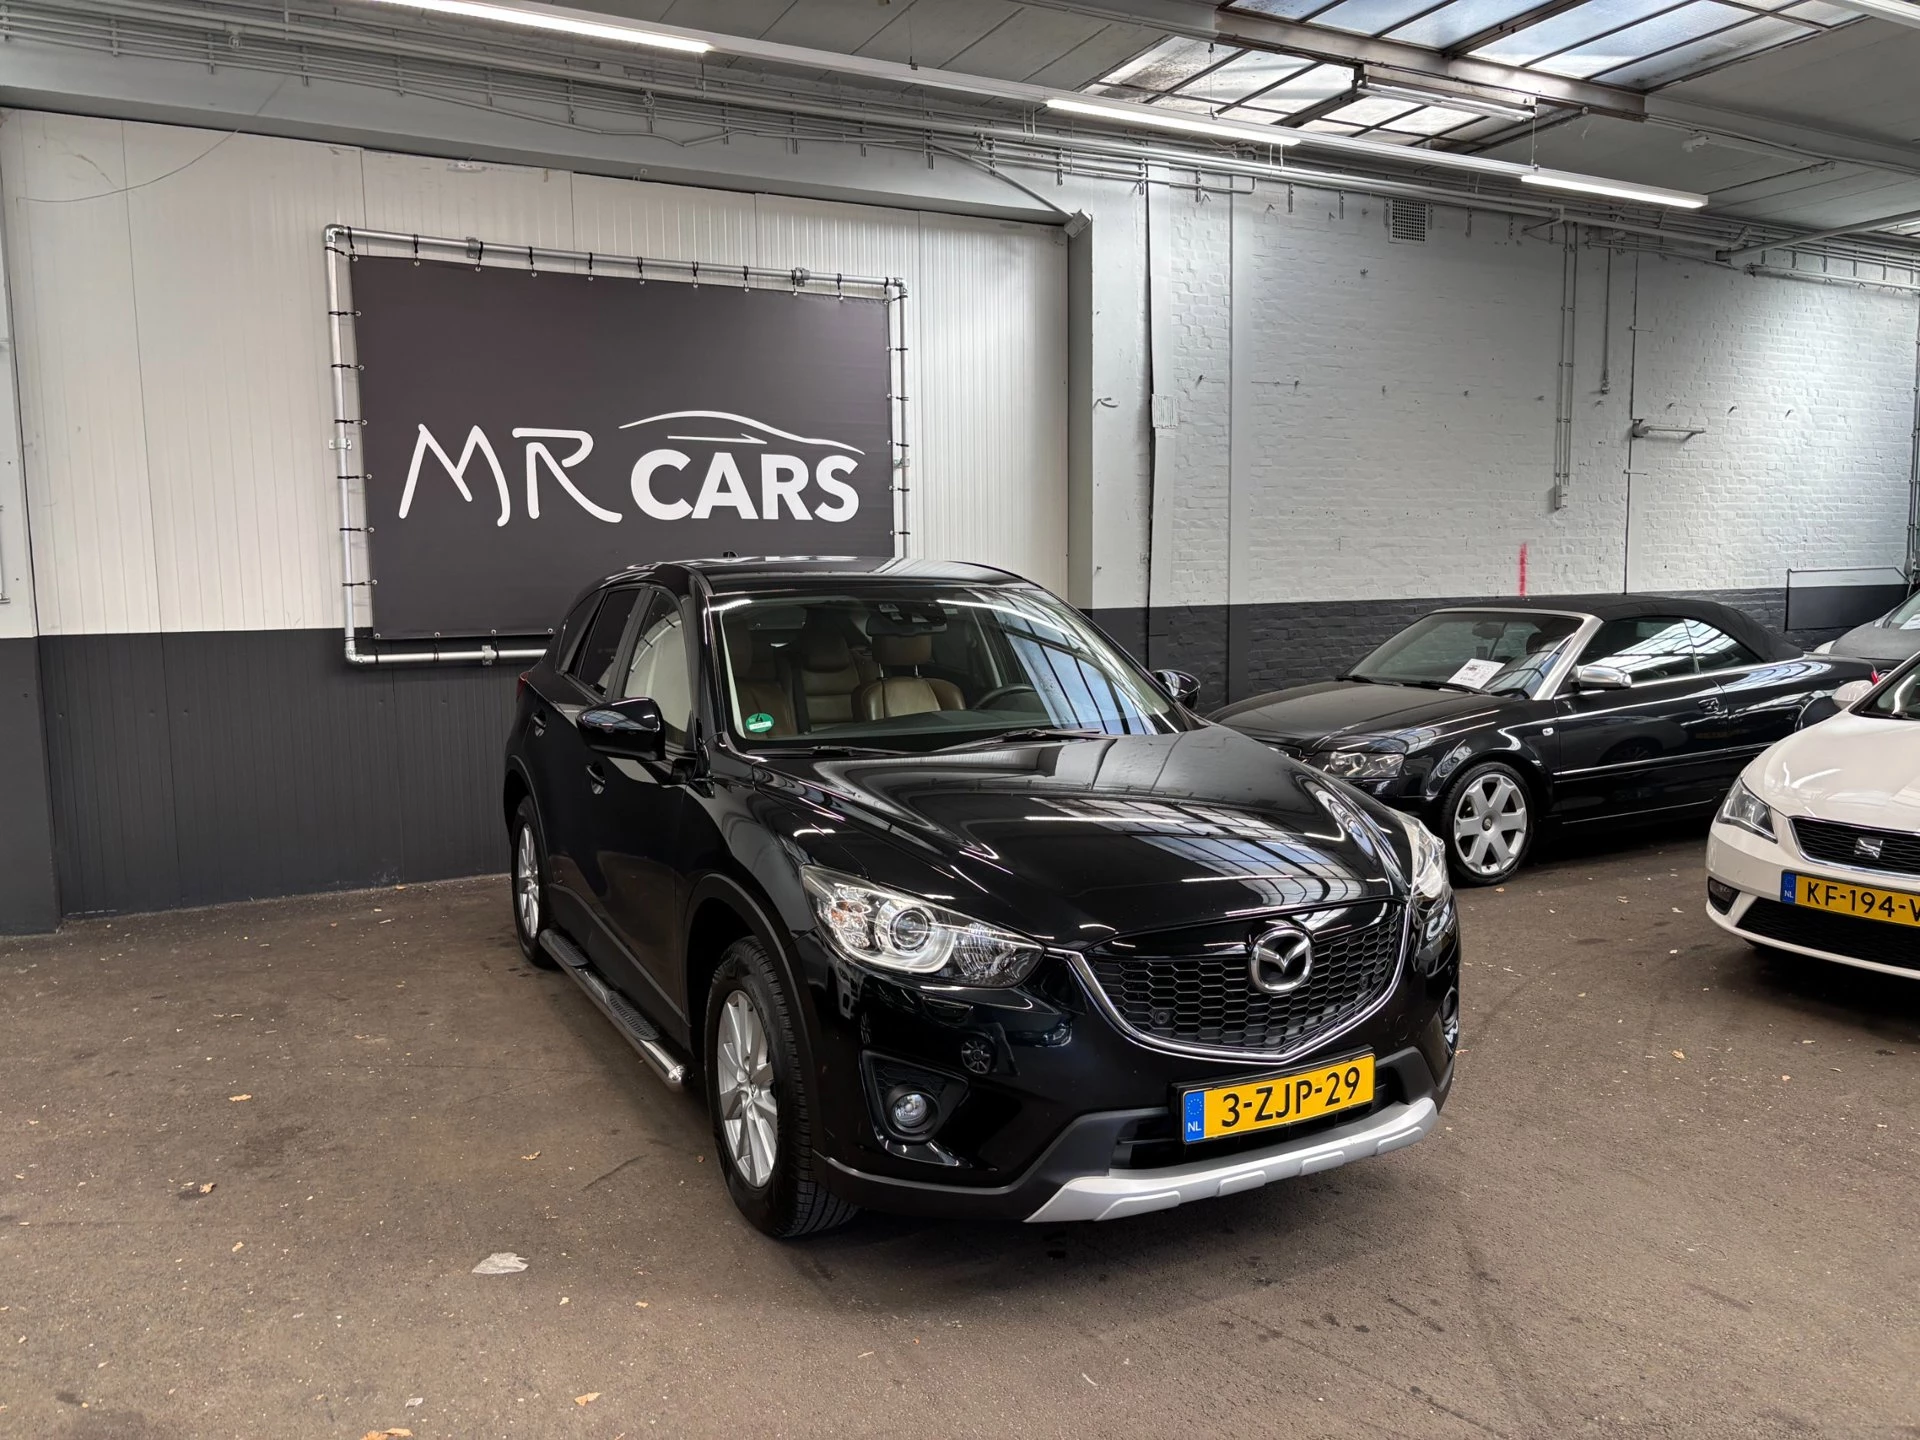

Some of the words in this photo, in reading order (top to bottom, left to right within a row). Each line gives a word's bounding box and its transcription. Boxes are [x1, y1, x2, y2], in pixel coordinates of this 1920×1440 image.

[398, 423, 623, 527] MR
[630, 448, 860, 523] CARS
[1783, 890, 1794, 899] NL
[1187, 1121, 1202, 1132] NL
[1221, 1066, 1361, 1128] 3-ZJP-29
